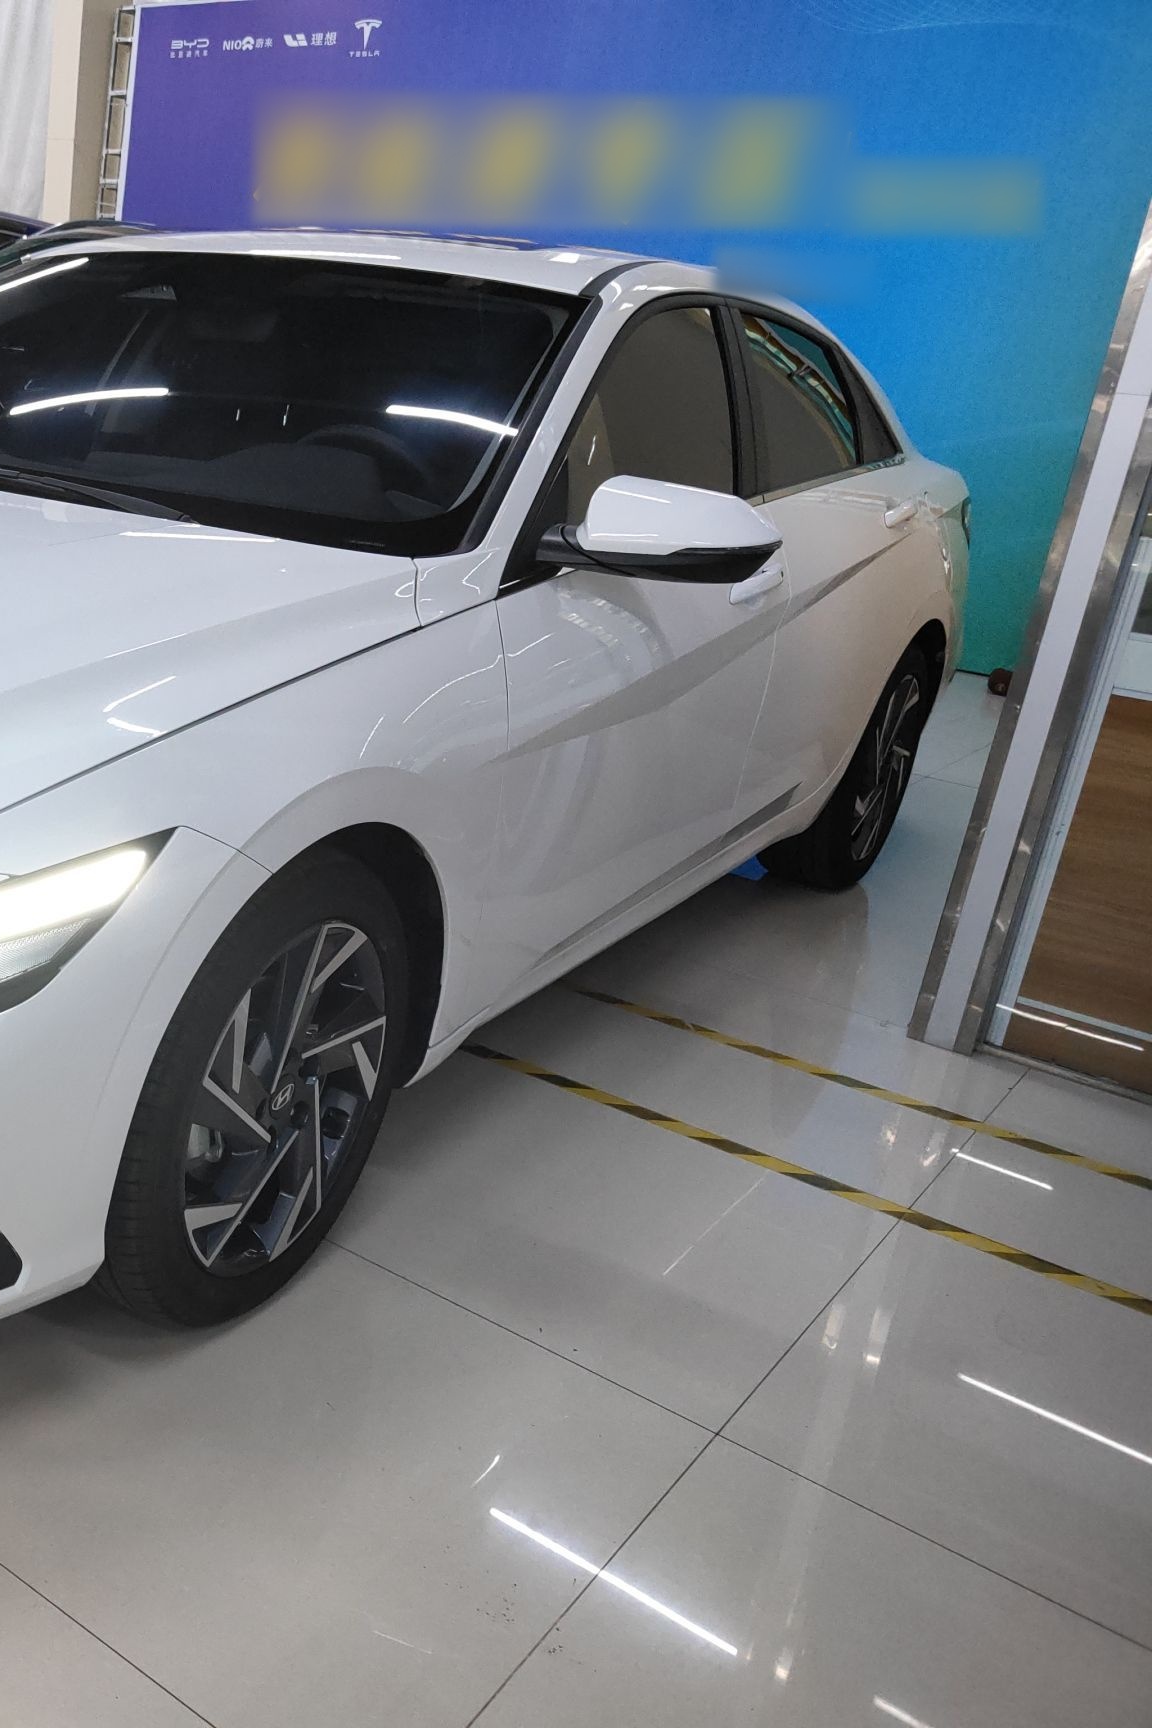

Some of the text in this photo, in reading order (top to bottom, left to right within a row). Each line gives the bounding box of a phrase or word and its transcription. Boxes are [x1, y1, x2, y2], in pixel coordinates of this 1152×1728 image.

[170, 38, 209, 49] BYD
[310, 31, 337, 46] 理想
[223, 39, 242, 51] NIO
